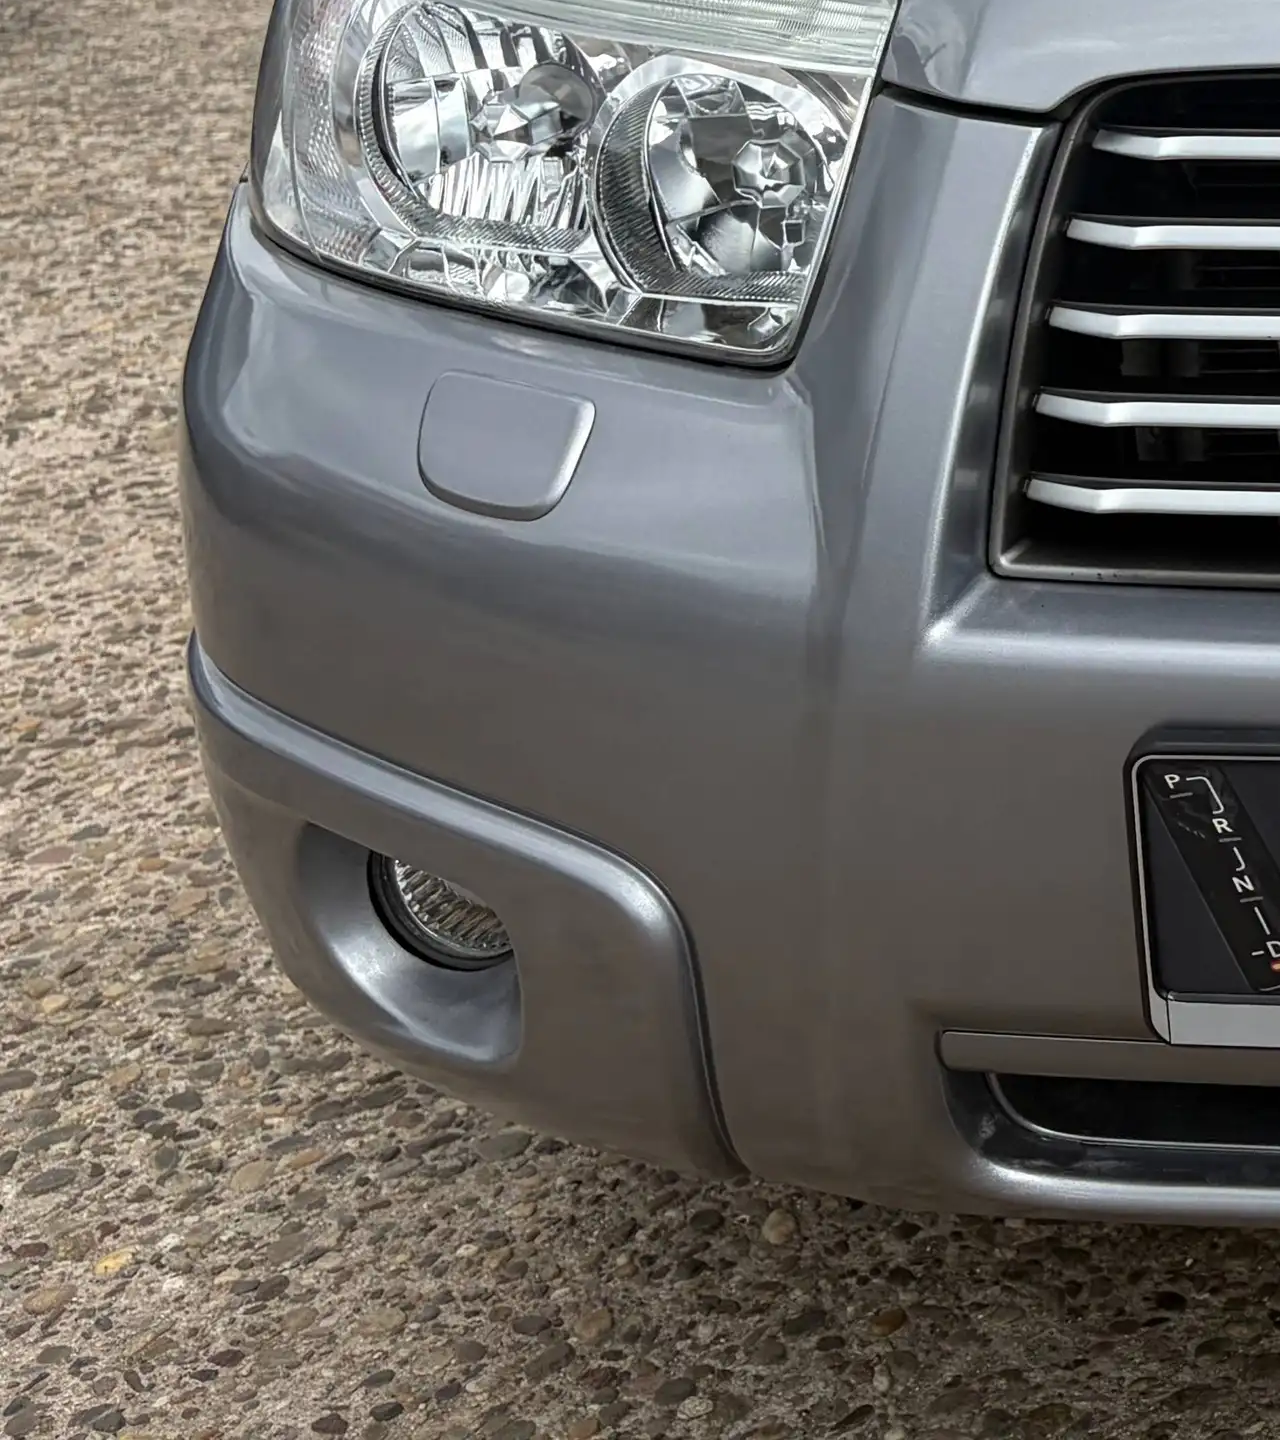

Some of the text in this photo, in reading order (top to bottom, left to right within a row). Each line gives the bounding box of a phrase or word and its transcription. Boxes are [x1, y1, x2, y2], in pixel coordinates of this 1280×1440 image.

[1164, 773, 1181, 790] P
[1211, 817, 1234, 835] R
[1232, 874, 1255, 893] N
